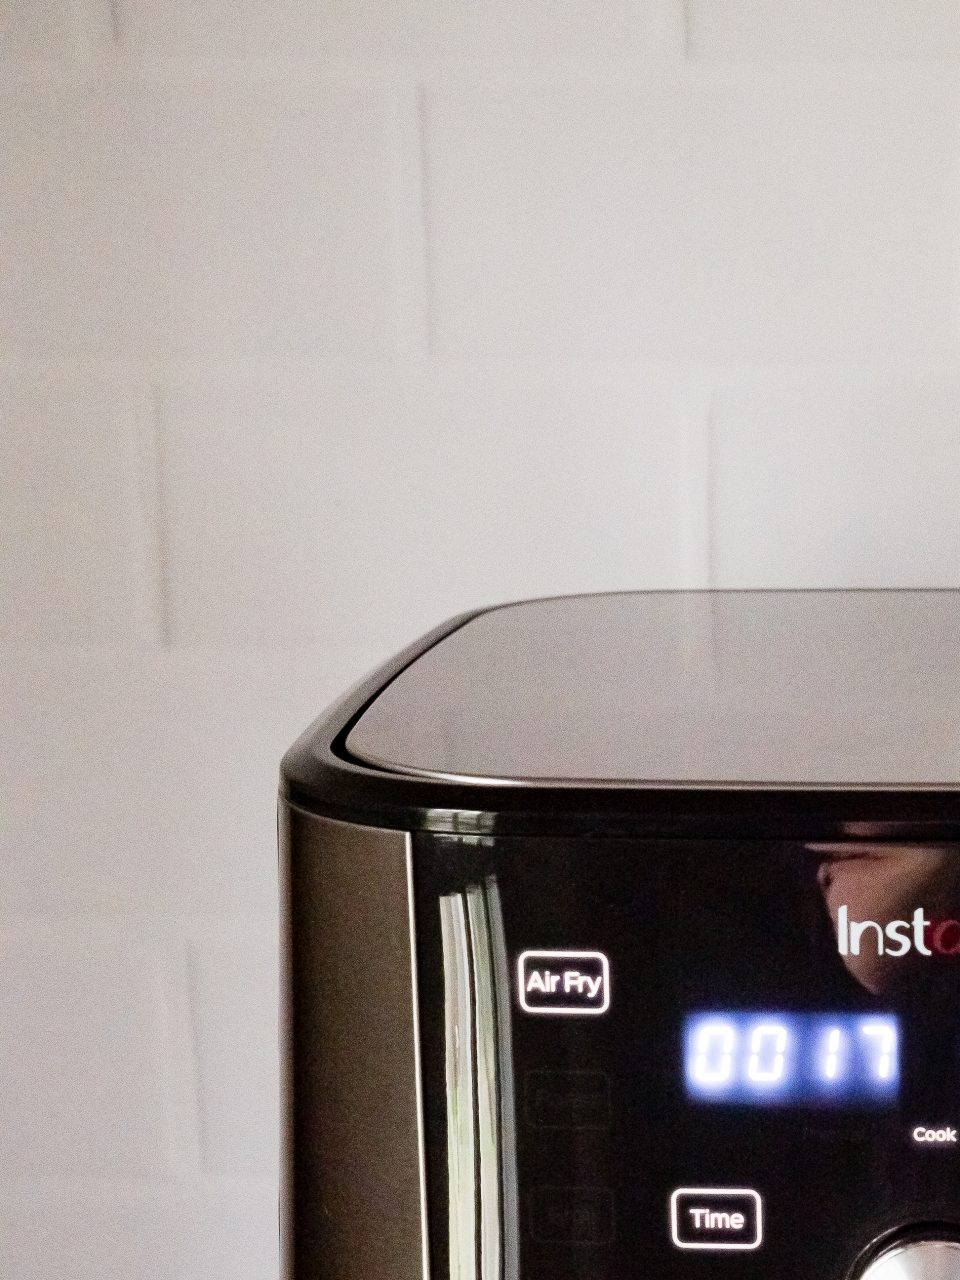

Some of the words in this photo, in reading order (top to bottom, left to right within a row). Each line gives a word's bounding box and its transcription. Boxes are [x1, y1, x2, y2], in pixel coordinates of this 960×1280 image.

[526, 970, 560, 994] Air
[563, 970, 603, 999] Fry
[693, 1024, 895, 1084] 0017
[913, 1126, 957, 1143] Cook
[690, 1207, 745, 1230] Time
